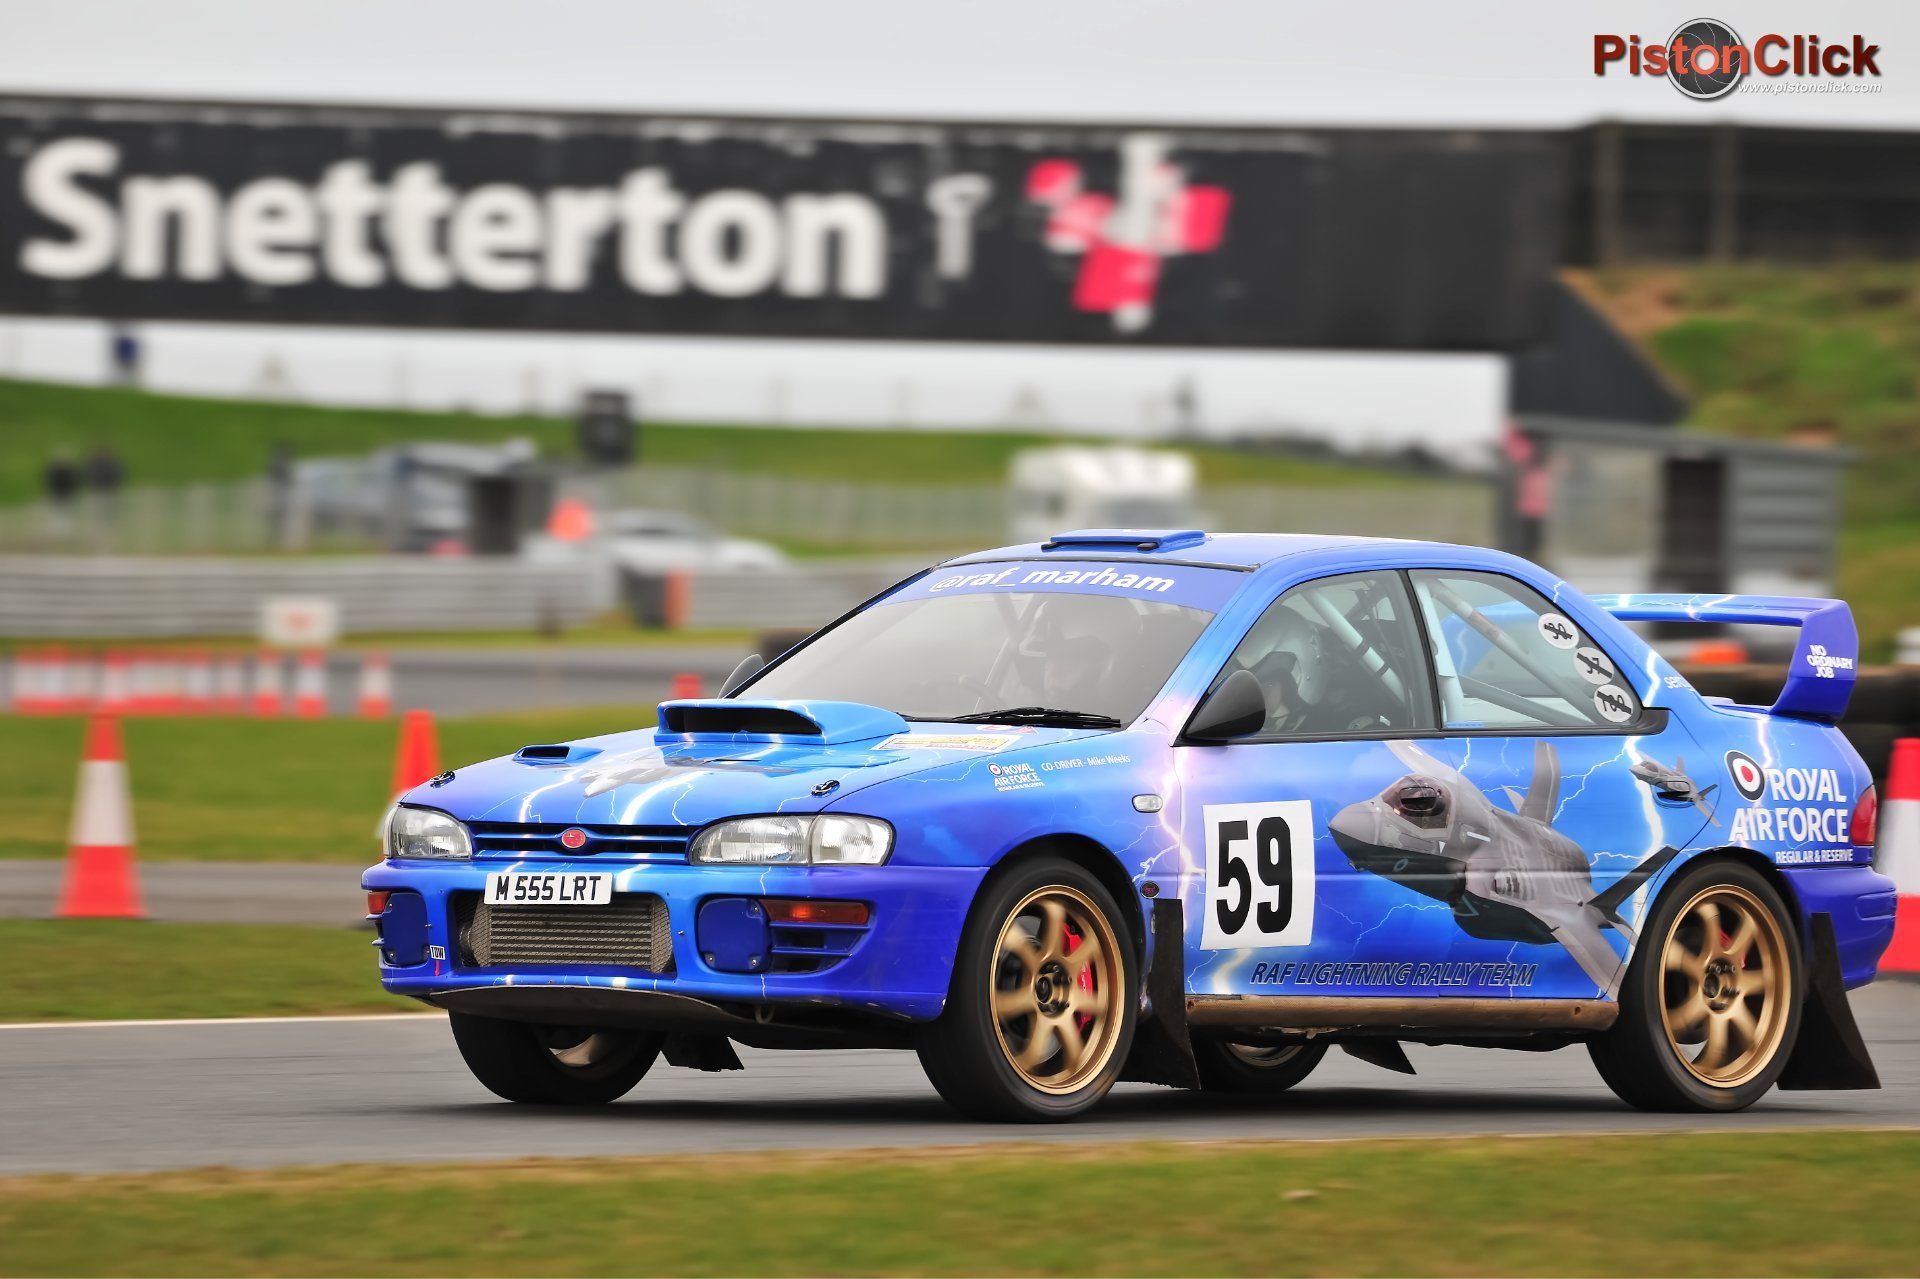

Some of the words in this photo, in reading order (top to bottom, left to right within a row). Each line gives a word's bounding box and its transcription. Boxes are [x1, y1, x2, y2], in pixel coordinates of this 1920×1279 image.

[20, 136, 889, 301] Snetterton
[929, 567, 1175, 592] @raf_marham
[1809, 644, 1827, 656] NO
[1806, 655, 1853, 669] ORDINARY
[1815, 666, 1835, 678] JOB
[1002, 762, 1034, 775] ROYAL
[1041, 758, 1084, 771] CO-DRIVER
[1087, 756, 1106, 766] Mike
[1105, 754, 1130, 764] Weeks
[995, 776, 1009, 786] AIR
[1008, 772, 1041, 784] FORCE
[1766, 767, 1847, 802] ROYAL
[1728, 807, 1776, 841] AIR
[1775, 807, 1848, 842] FORCE
[1776, 850, 1814, 863] REGULAR
[1814, 850, 1820, 862] &
[1820, 849, 1853, 862] RESERVE
[1216, 816, 1293, 935] 59
[495, 875, 510, 900] M
[515, 875, 555, 900] 555
[559, 875, 601, 900] LRT
[1250, 962, 1295, 985] RAF
[1295, 963, 1413, 986] LIGHTNING
[1412, 963, 1479, 986] RALLY
[1478, 963, 1538, 987] TEAM
